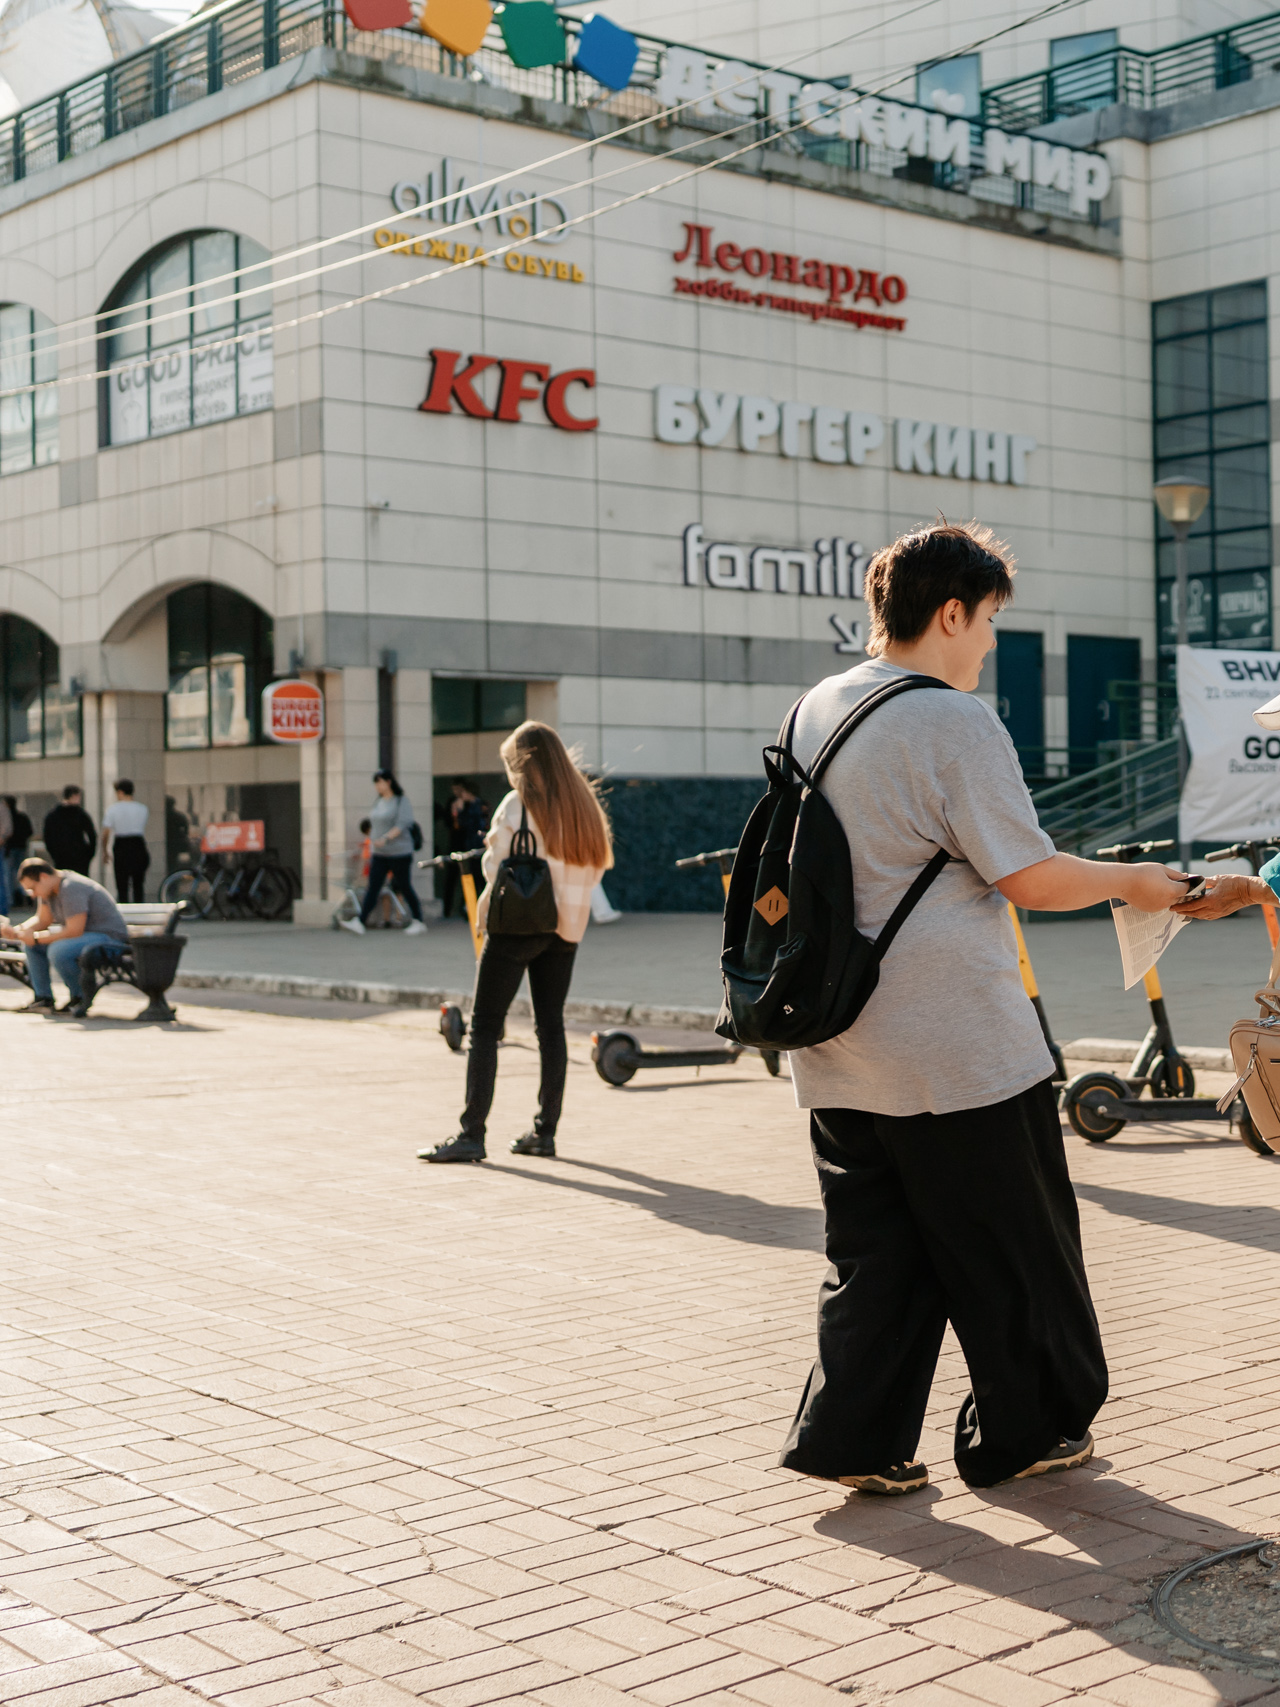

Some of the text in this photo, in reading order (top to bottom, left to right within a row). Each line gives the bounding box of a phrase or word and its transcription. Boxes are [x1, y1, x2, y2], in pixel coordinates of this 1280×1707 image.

[374, 228, 585, 283] ОДЕЖДА ОБУВЬ
[673, 221, 907, 306] Леонардо
[673, 276, 907, 331] хобби-гипермаркет
[117, 321, 273, 392] GOOD PRICE
[418, 348, 599, 431] KFC
[653, 384, 1038, 485] БУРГЕР КИНГ
[683, 523, 868, 599] famili
[272, 711, 320, 727] KING
